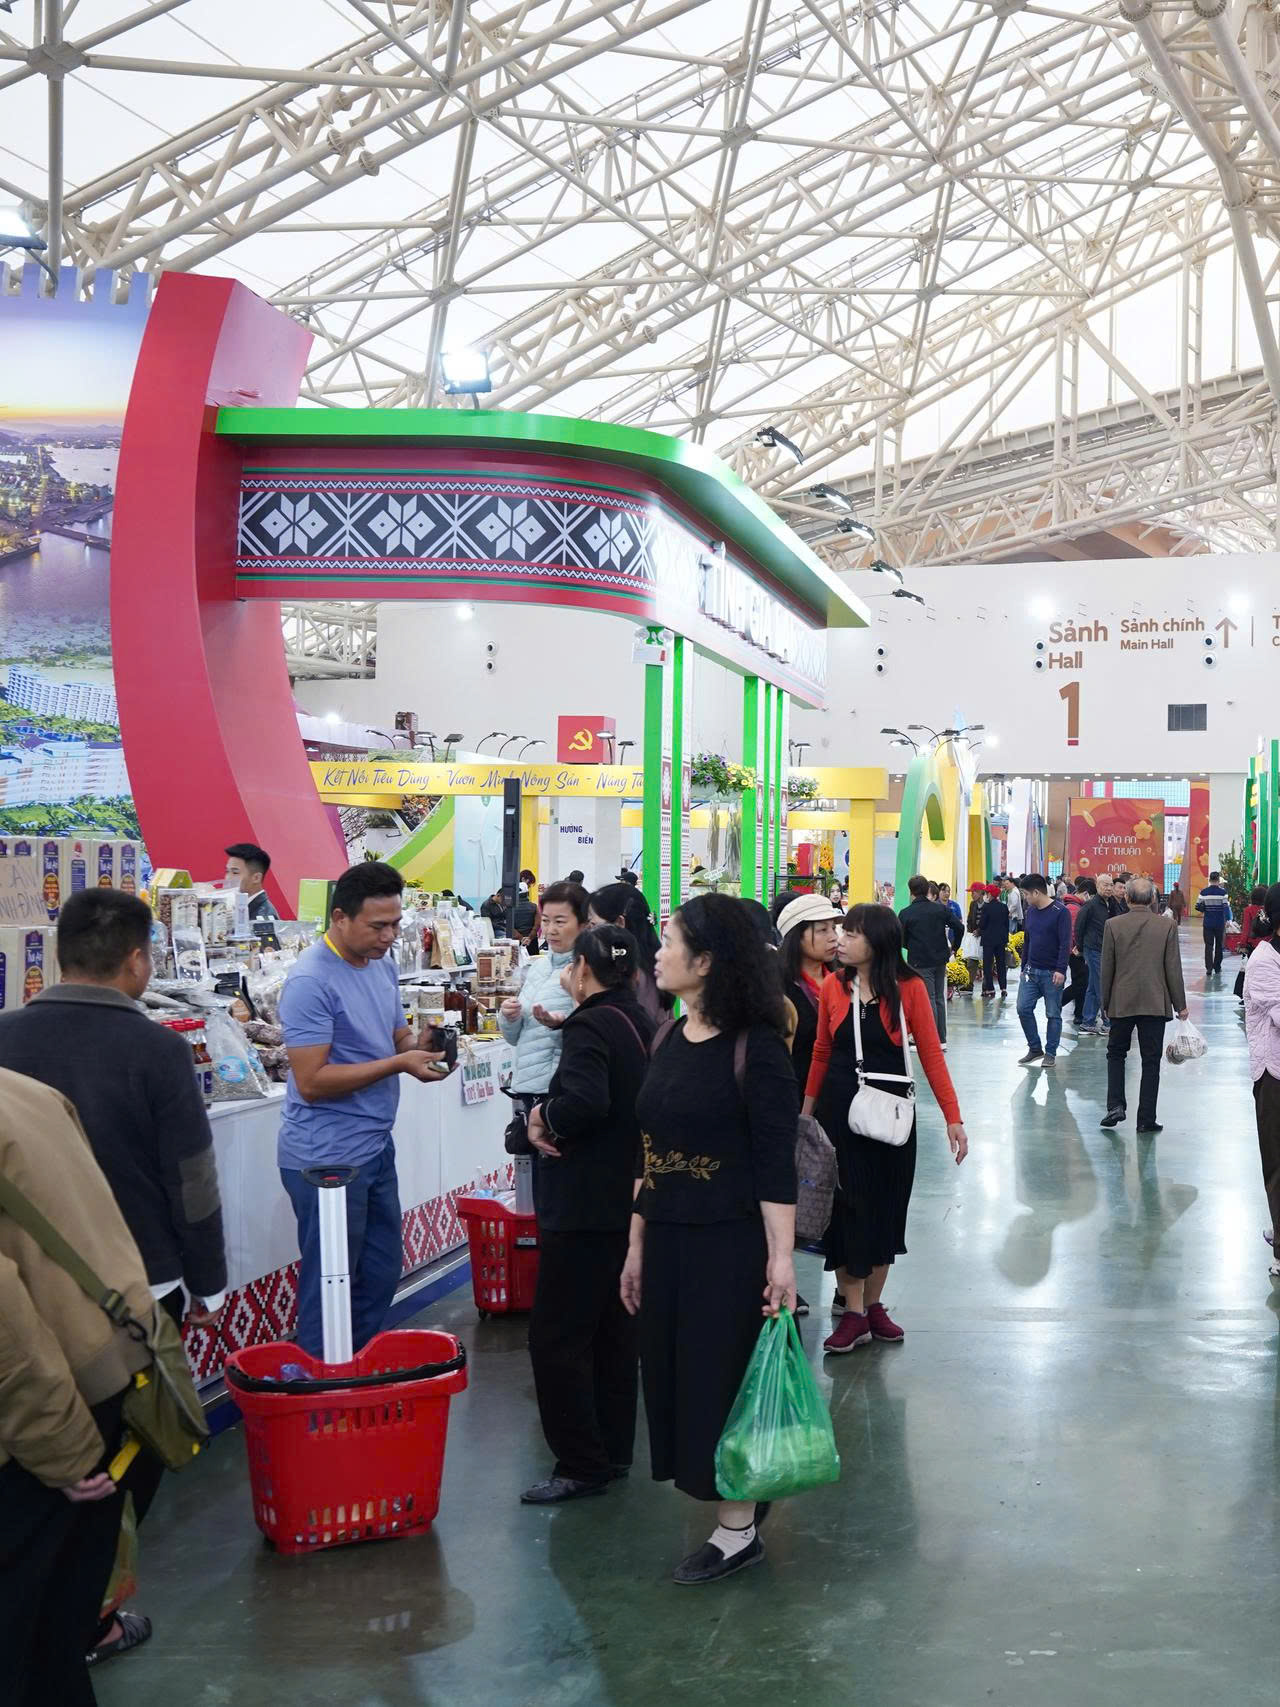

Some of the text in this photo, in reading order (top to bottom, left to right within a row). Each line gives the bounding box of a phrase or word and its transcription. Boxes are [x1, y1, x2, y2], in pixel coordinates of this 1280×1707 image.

[1048, 618, 1109, 644] Sảnh
[1120, 617, 1206, 634] Sảnh chính
[1120, 638, 1174, 651] Main Hall
[1048, 652, 1084, 670] Hall
[1058, 681, 1080, 739] 1
[1092, 844, 1109, 856] TẾT
